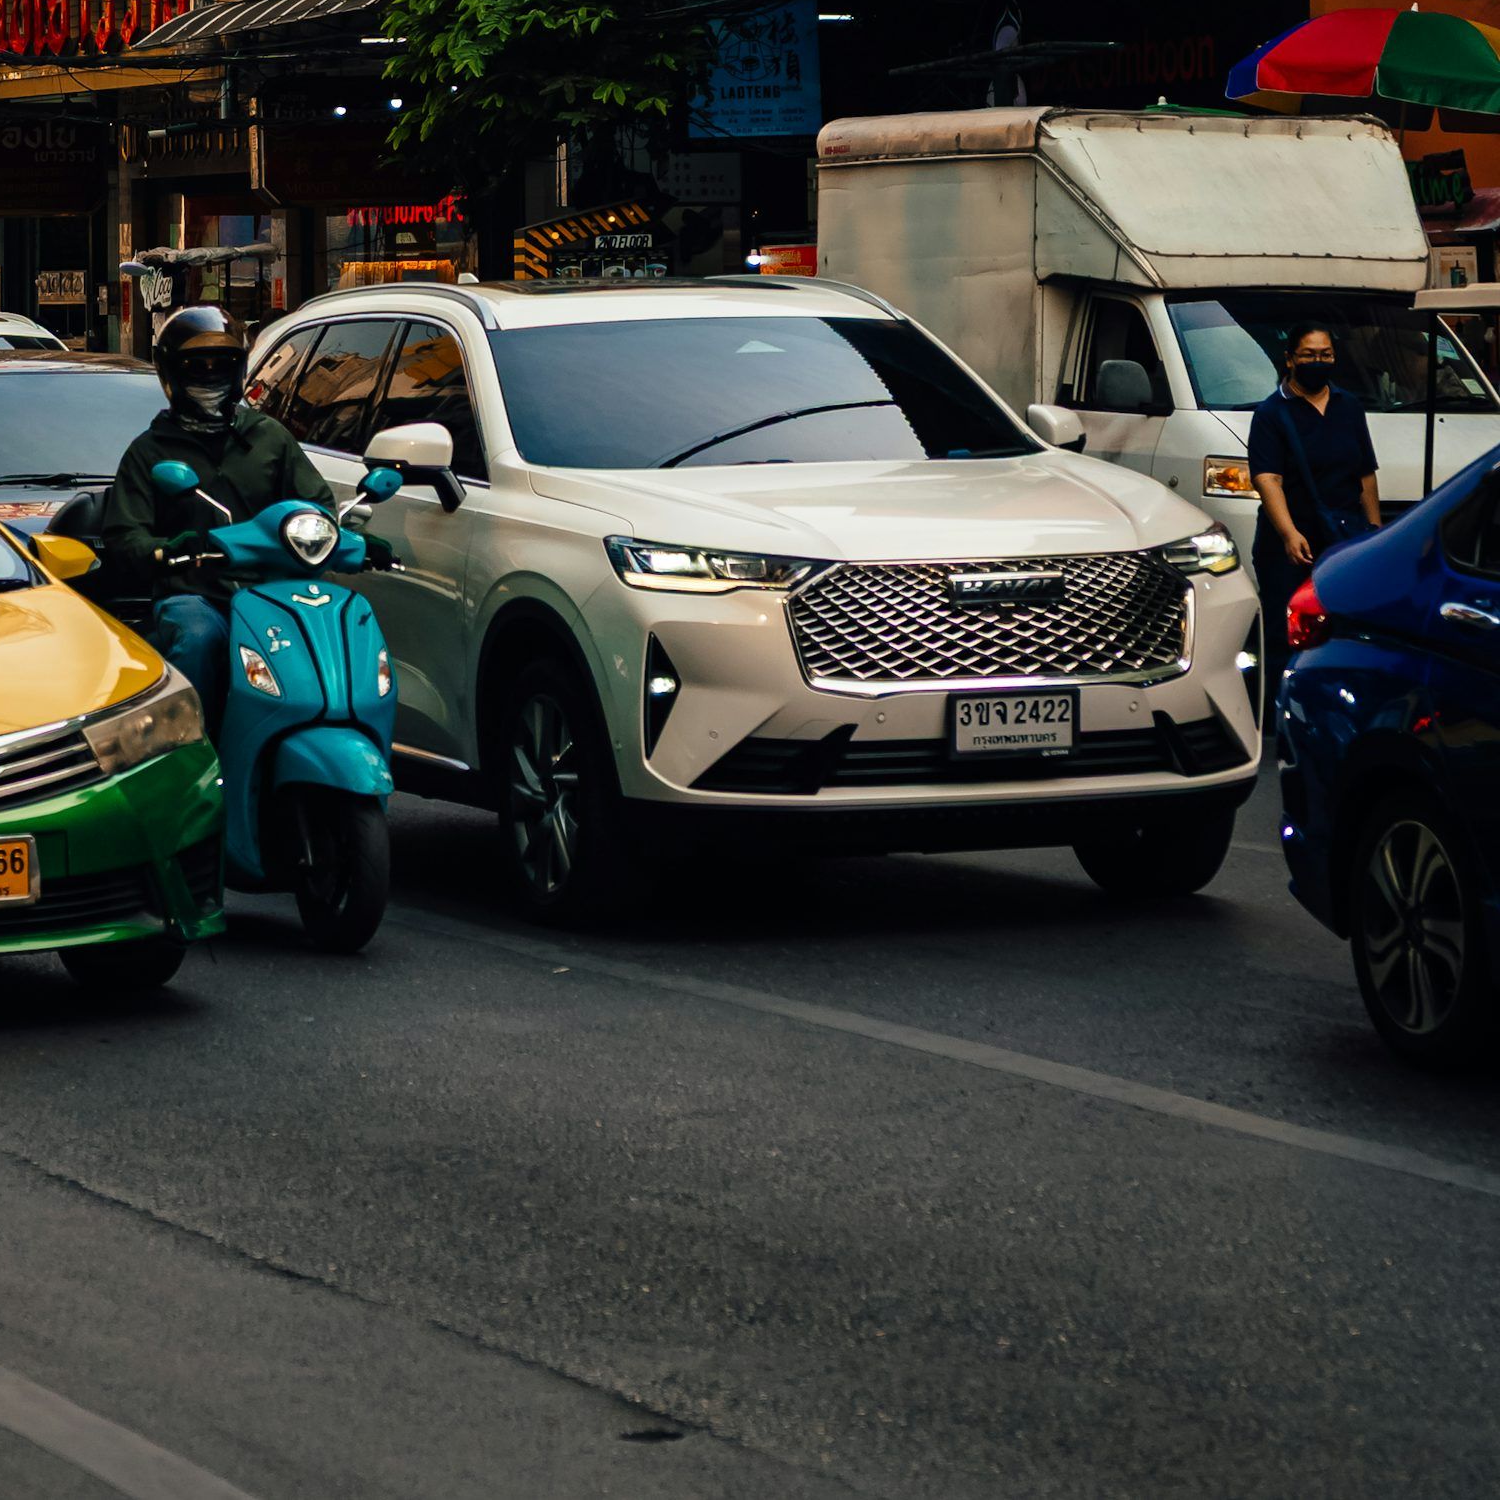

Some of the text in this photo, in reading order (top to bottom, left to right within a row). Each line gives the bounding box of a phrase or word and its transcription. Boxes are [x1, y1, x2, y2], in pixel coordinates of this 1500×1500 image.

[959, 698, 1071, 727] 3ขจ 2422
[972, 732, 1058, 751] กรุงเทพมหานคร
